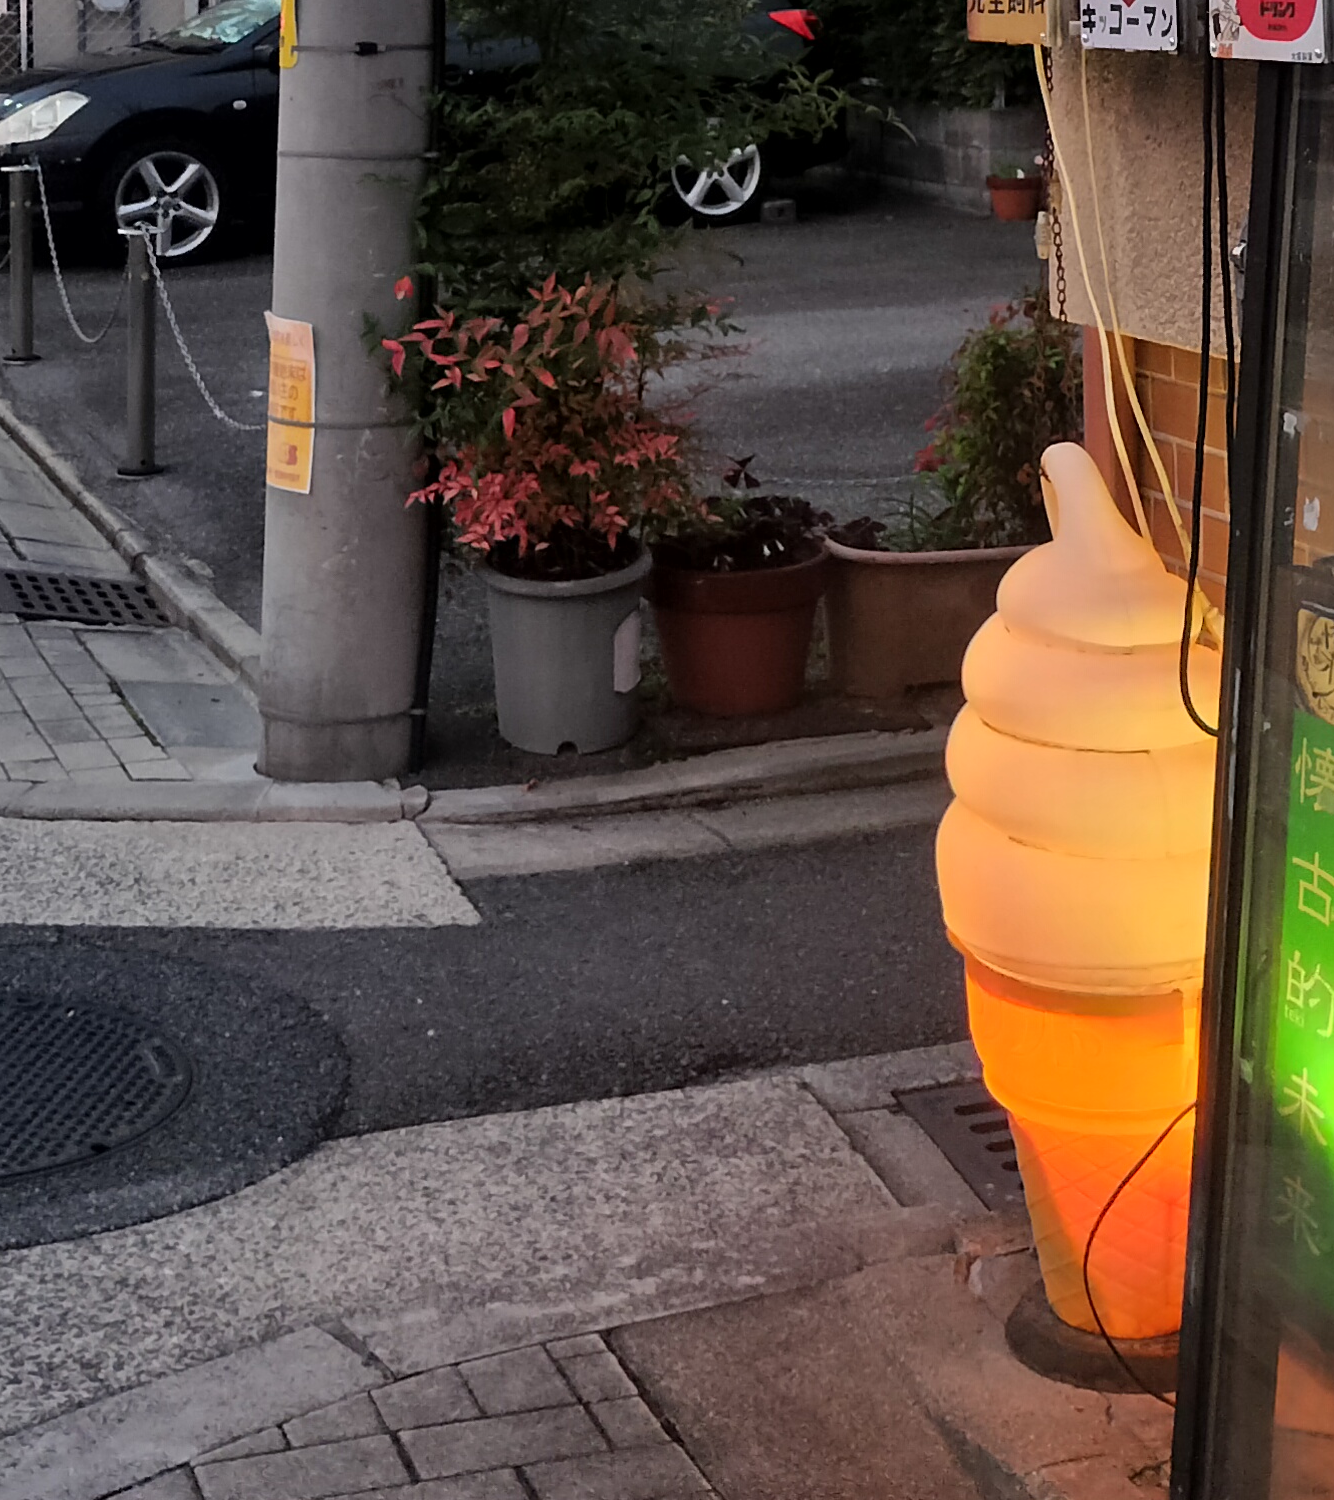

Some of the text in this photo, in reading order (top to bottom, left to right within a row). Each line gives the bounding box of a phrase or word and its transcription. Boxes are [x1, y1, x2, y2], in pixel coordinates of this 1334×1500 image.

[1081, 3, 1174, 38] キッコーマン
